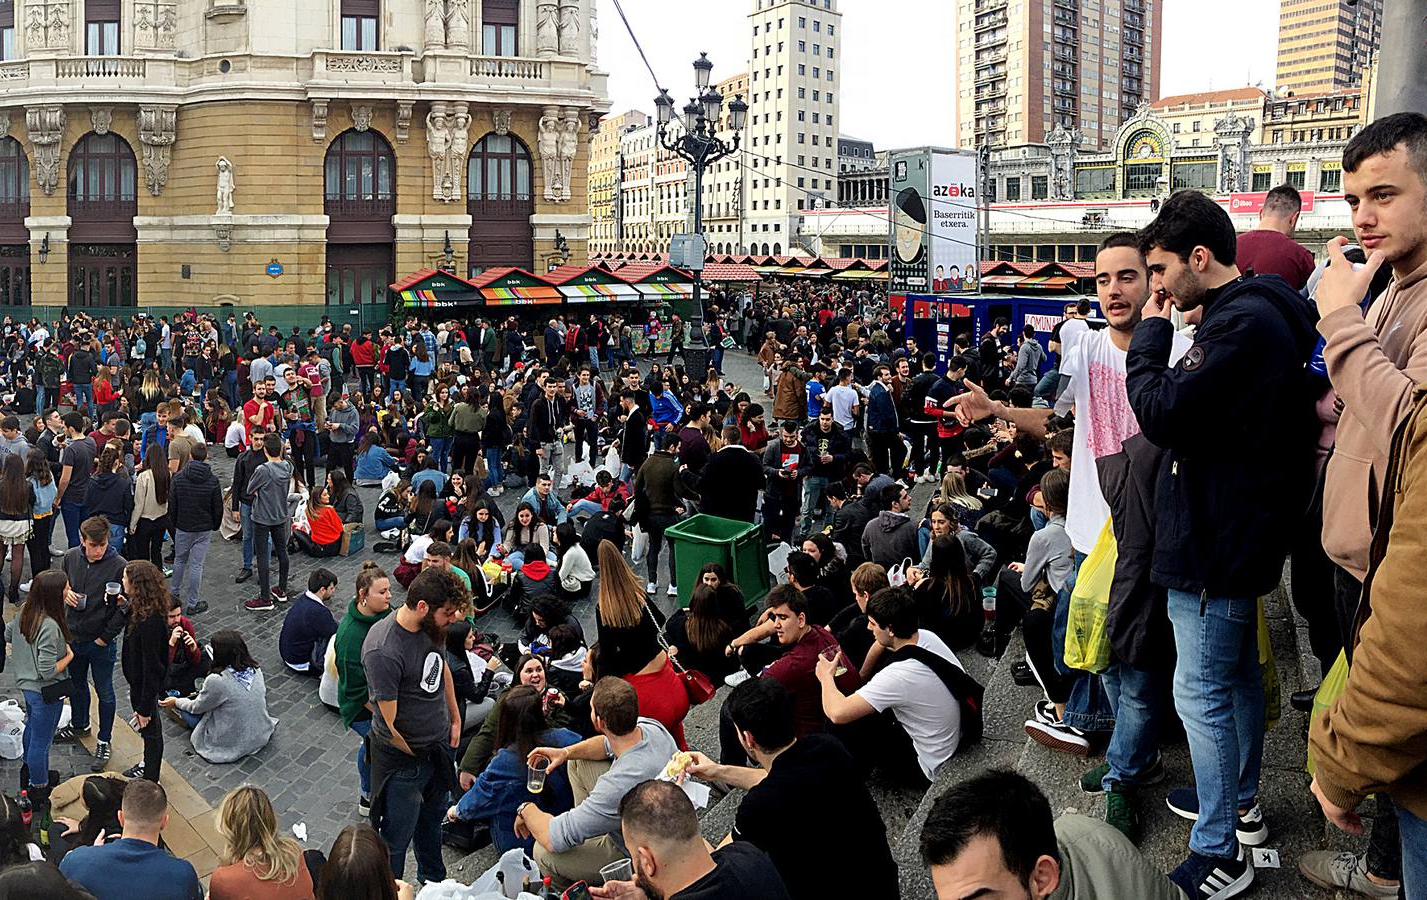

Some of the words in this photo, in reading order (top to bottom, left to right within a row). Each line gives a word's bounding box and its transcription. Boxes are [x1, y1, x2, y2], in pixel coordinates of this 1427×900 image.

[933, 182, 975, 198] azoka
[933, 209, 975, 219] Baserritik
[940, 220, 969, 228] etxera.
